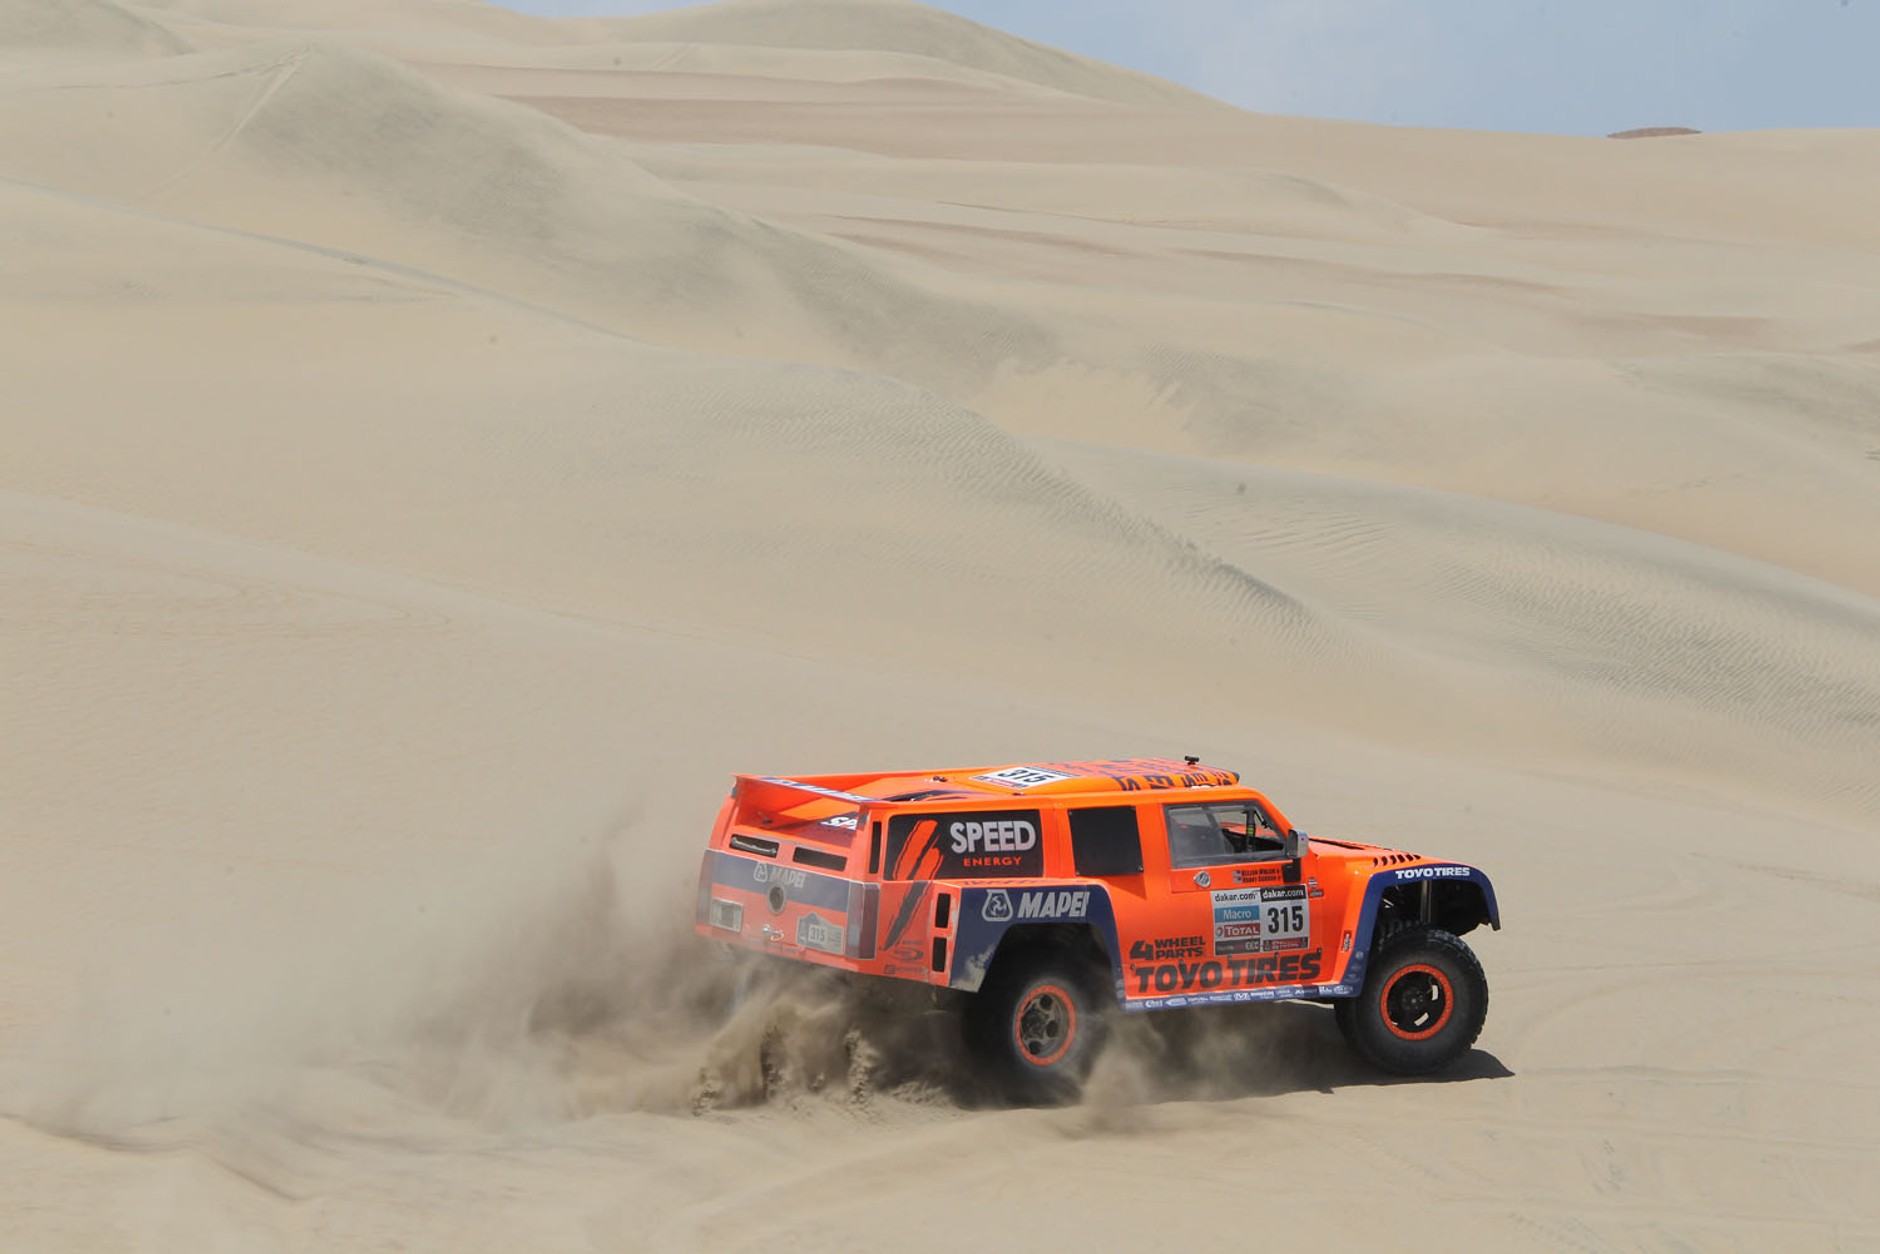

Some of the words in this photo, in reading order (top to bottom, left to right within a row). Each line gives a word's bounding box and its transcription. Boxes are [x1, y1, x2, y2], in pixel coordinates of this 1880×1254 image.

[997, 769, 1055, 783] 315
[950, 820, 1036, 854] SPEED
[963, 856, 1022, 867] ENERGY
[768, 866, 807, 889] MAPEI
[1395, 869, 1434, 880] TOYO
[1434, 867, 1470, 877] TIRES
[1214, 893, 1256, 902] dakar.com
[1262, 888, 1305, 899] dakar.com
[1017, 891, 1091, 919] MAPEI
[1223, 909, 1252, 920] Macro
[1267, 905, 1304, 934] 315
[809, 926, 827, 939] 315
[1129, 940, 1155, 961] 4
[1154, 936, 1206, 948] WHEEL
[1155, 947, 1204, 960] PARTS
[1134, 959, 1223, 993] TOYO
[1226, 947, 1322, 986] TIRES
